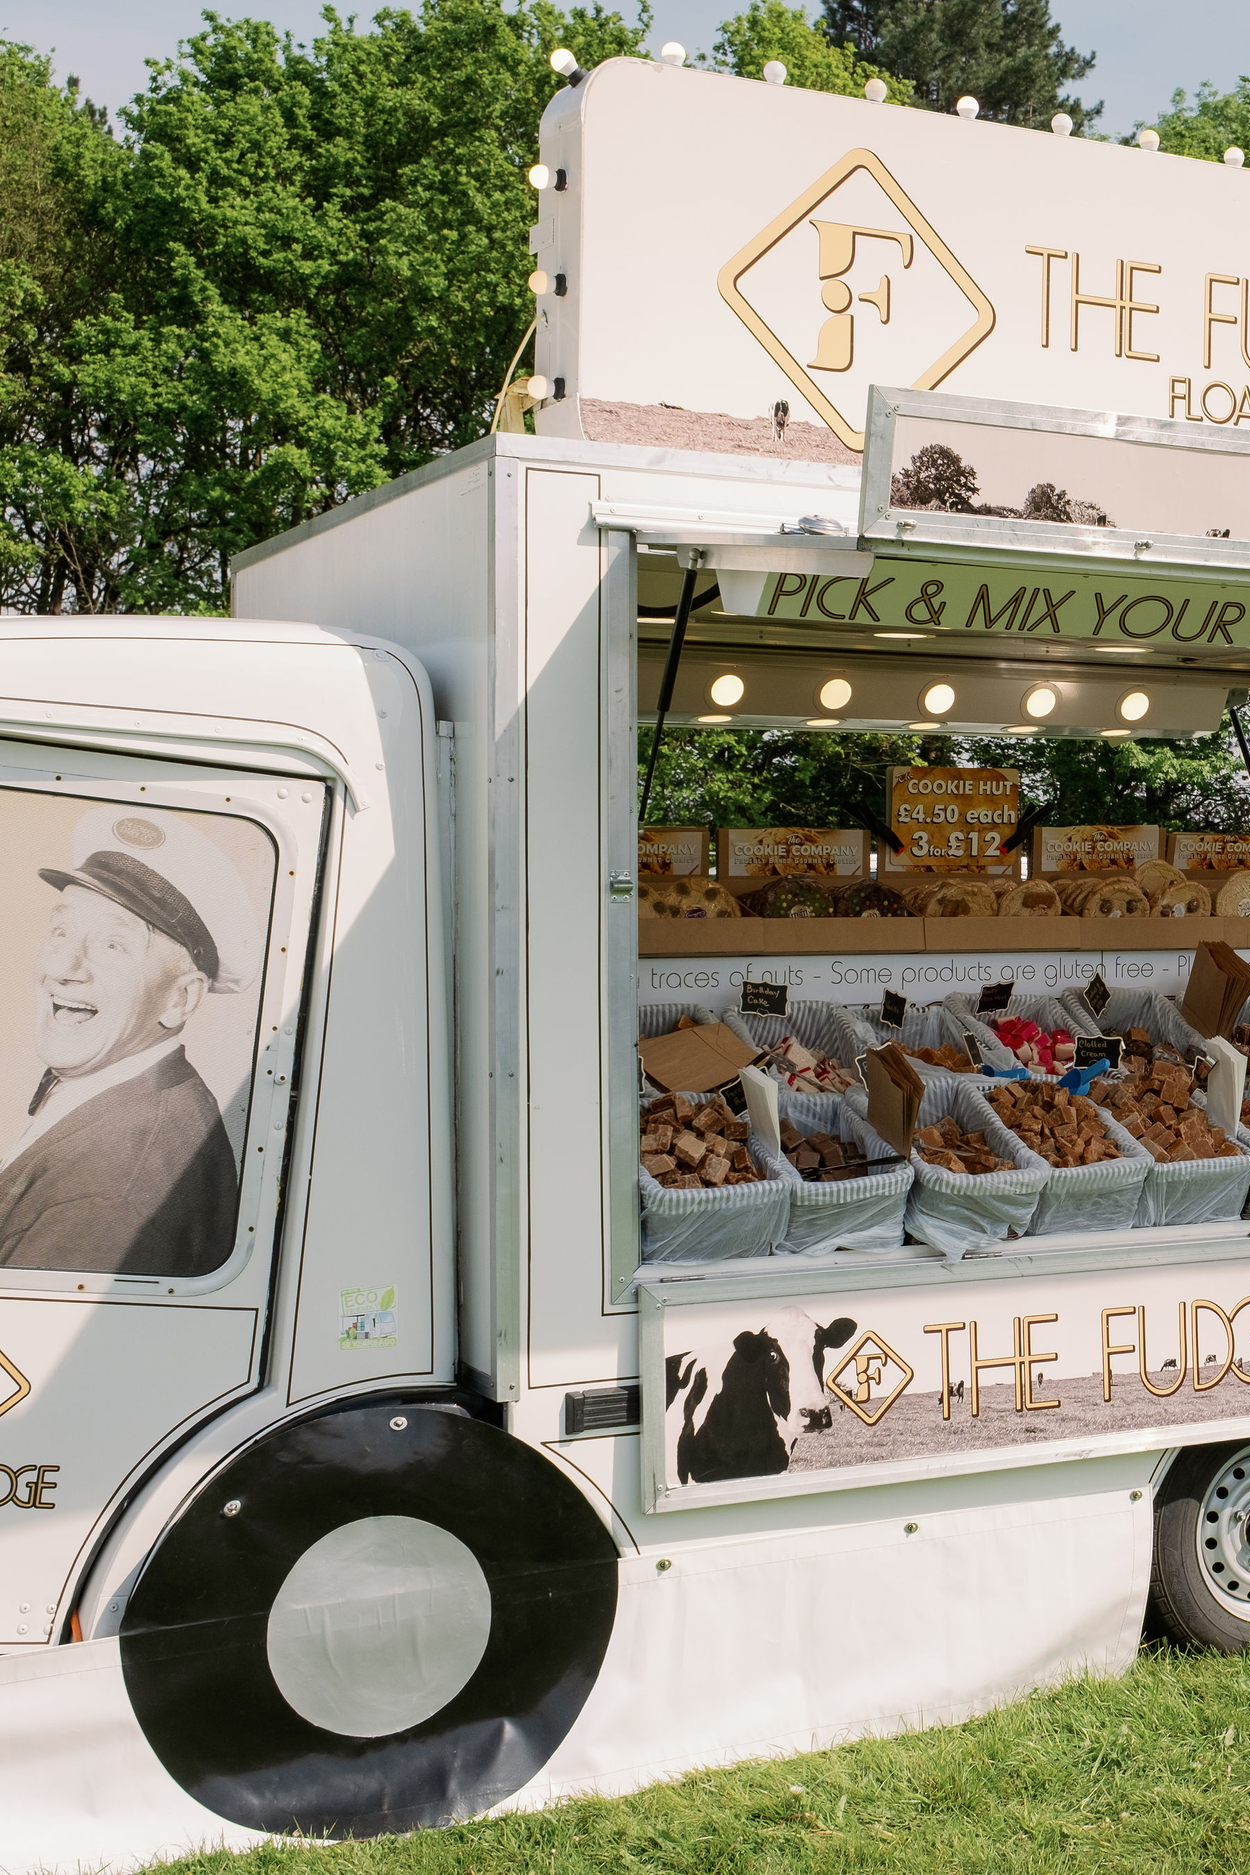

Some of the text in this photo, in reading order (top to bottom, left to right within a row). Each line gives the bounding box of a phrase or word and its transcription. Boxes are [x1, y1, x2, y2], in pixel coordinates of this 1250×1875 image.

[1024, 244, 1161, 362] THE
[767, 572, 896, 622] PICK
[904, 579, 947, 627] &
[965, 583, 1077, 634] MIX
[1091, 591, 1246, 645] YOUR
[907, 779, 1013, 796] COOKIE HUT
[897, 803, 1016, 824] £4.50 each
[786, 834, 800, 844] The
[1092, 831, 1107, 842] The
[734, 844, 859, 857] COOKIE COMPANY
[911, 831, 1001, 858] 3 for £12
[1046, 841, 1155, 852] COOKIE COMPANY
[1179, 842, 1223, 852] COOKIE
[650, 966, 720, 989] traces
[729, 962, 753, 988] of
[762, 965, 804, 985] nuts
[830, 960, 893, 985] Some
[902, 959, 993, 990] products
[1000, 963, 1037, 981] are
[1044, 955, 1106, 987] gluten
[1115, 954, 1154, 978] free
[746, 985, 780, 998] Birthday
[747, 996, 770, 1007] Cake
[1079, 1040, 1107, 1048] Clotted
[1081, 1050, 1106, 1058] Cream
[344, 1291, 378, 1309] ECO
[923, 1312, 1062, 1421] THE
